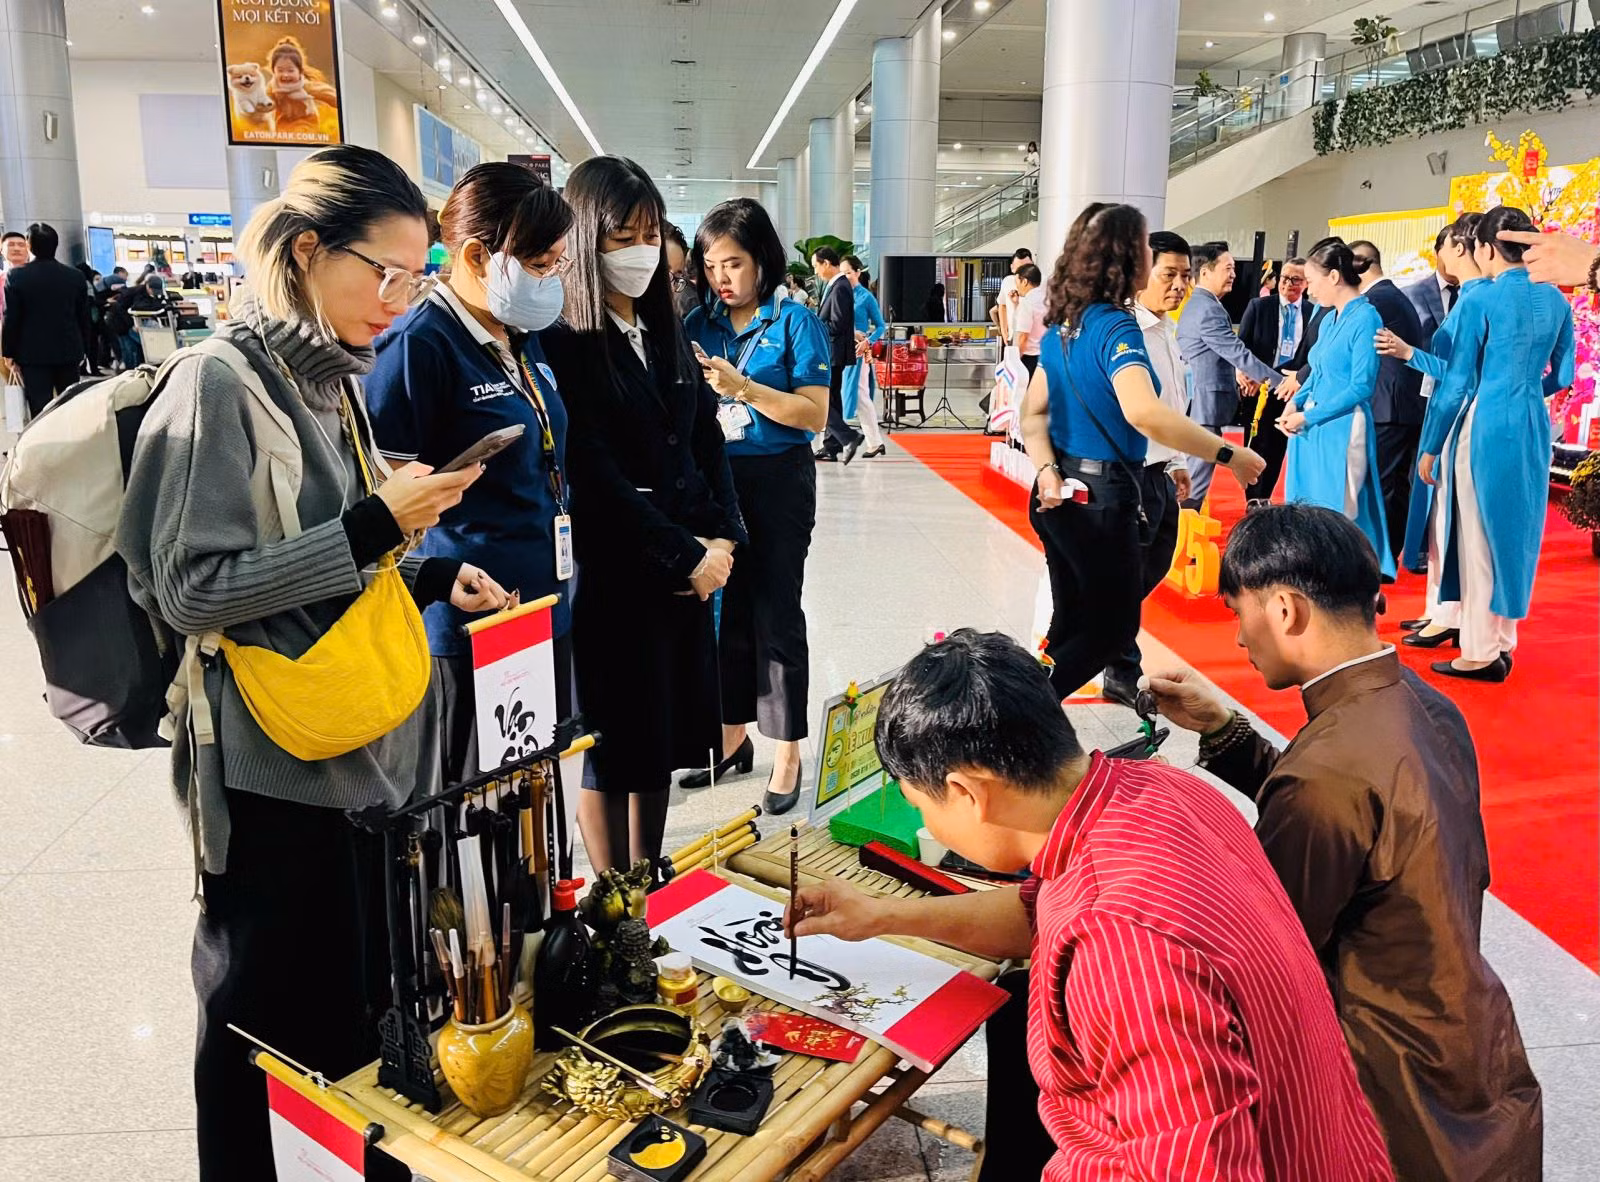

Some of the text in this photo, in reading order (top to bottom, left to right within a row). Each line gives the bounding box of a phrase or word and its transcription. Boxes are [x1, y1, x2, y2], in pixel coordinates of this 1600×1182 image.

[233, 8, 320, 25] MỌI KẾT NỐI
[243, 130, 330, 142] EATONPARK.COM.VN
[470, 383, 495, 396] TIA
